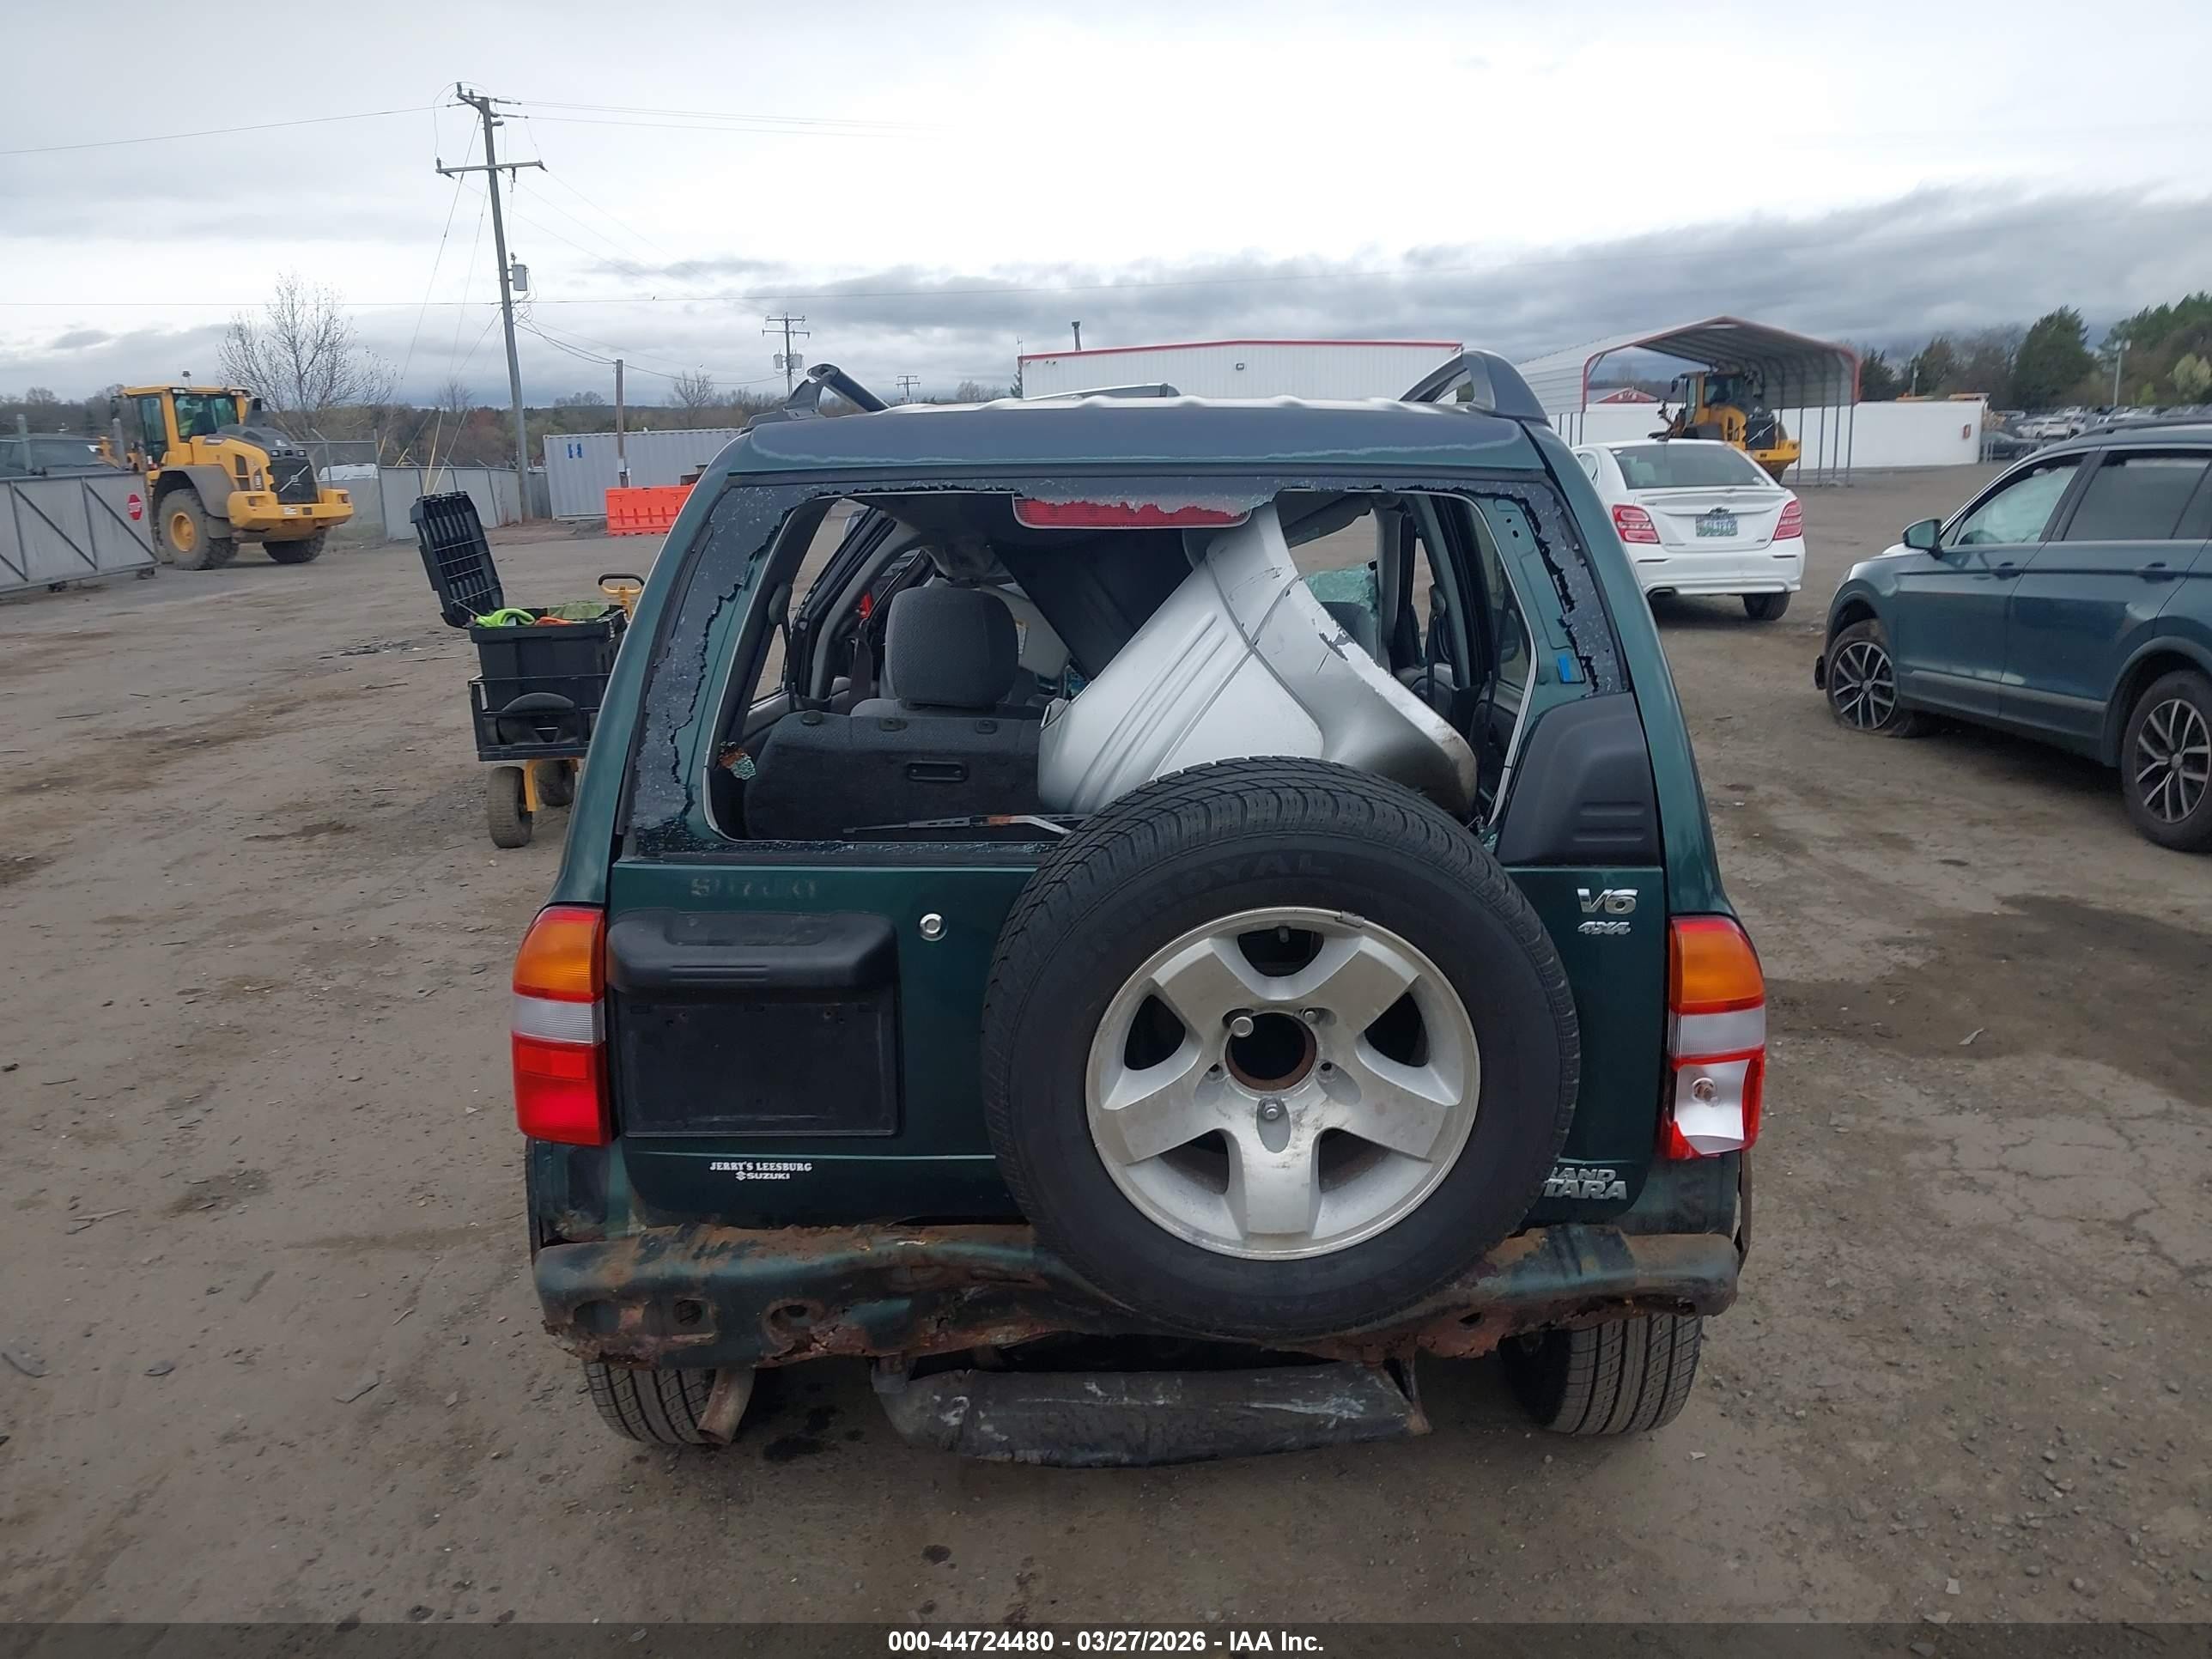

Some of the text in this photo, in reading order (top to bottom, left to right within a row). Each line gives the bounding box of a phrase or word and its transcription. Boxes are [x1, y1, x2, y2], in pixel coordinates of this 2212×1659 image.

[1577, 888, 1639, 915] V6
[709, 1161, 813, 1172] JERRY'S LEESBURG
[1548, 1166, 1617, 1182] AND
[1544, 1178, 1627, 1200] TARA
